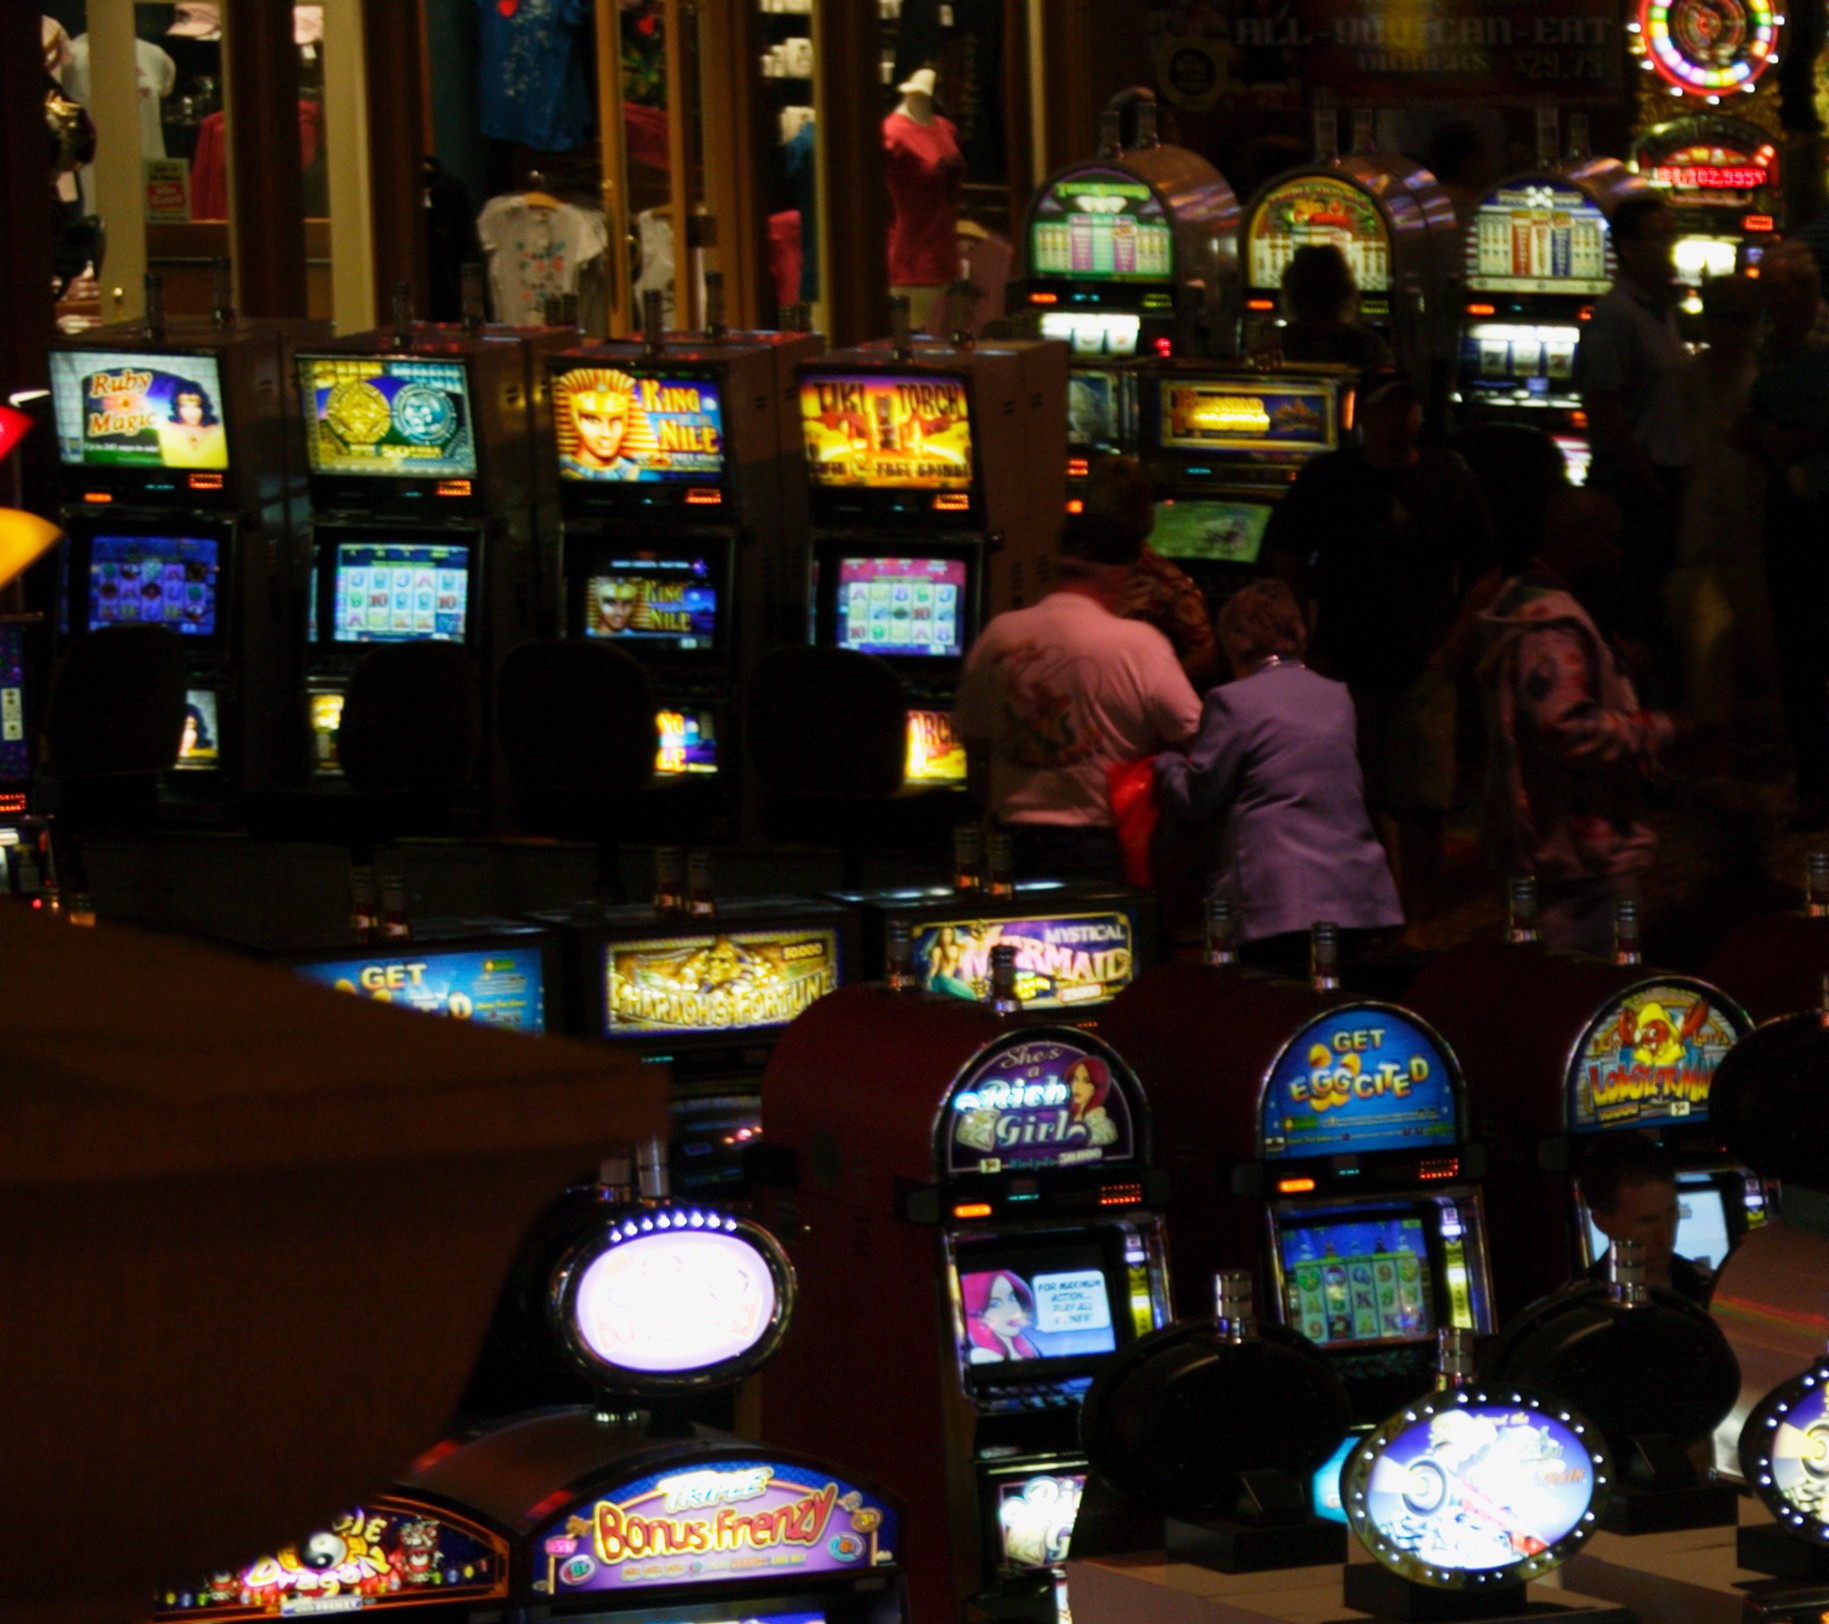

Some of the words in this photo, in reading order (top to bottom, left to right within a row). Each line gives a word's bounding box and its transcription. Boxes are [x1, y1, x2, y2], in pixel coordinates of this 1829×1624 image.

[90, 368, 153, 398] Ruby
[88, 411, 157, 437] Magic
[1045, 924, 1122, 948] MYSTICAL
[958, 933, 1131, 986] MRMAID
[360, 963, 427, 992] GET
[1332, 1029, 1386, 1053] GET
[1000, 1046, 1060, 1069] She's
[985, 1073, 1071, 1110] Rich
[1290, 1055, 1431, 1103] EGGCITED
[997, 1116, 1087, 1146] Girl
